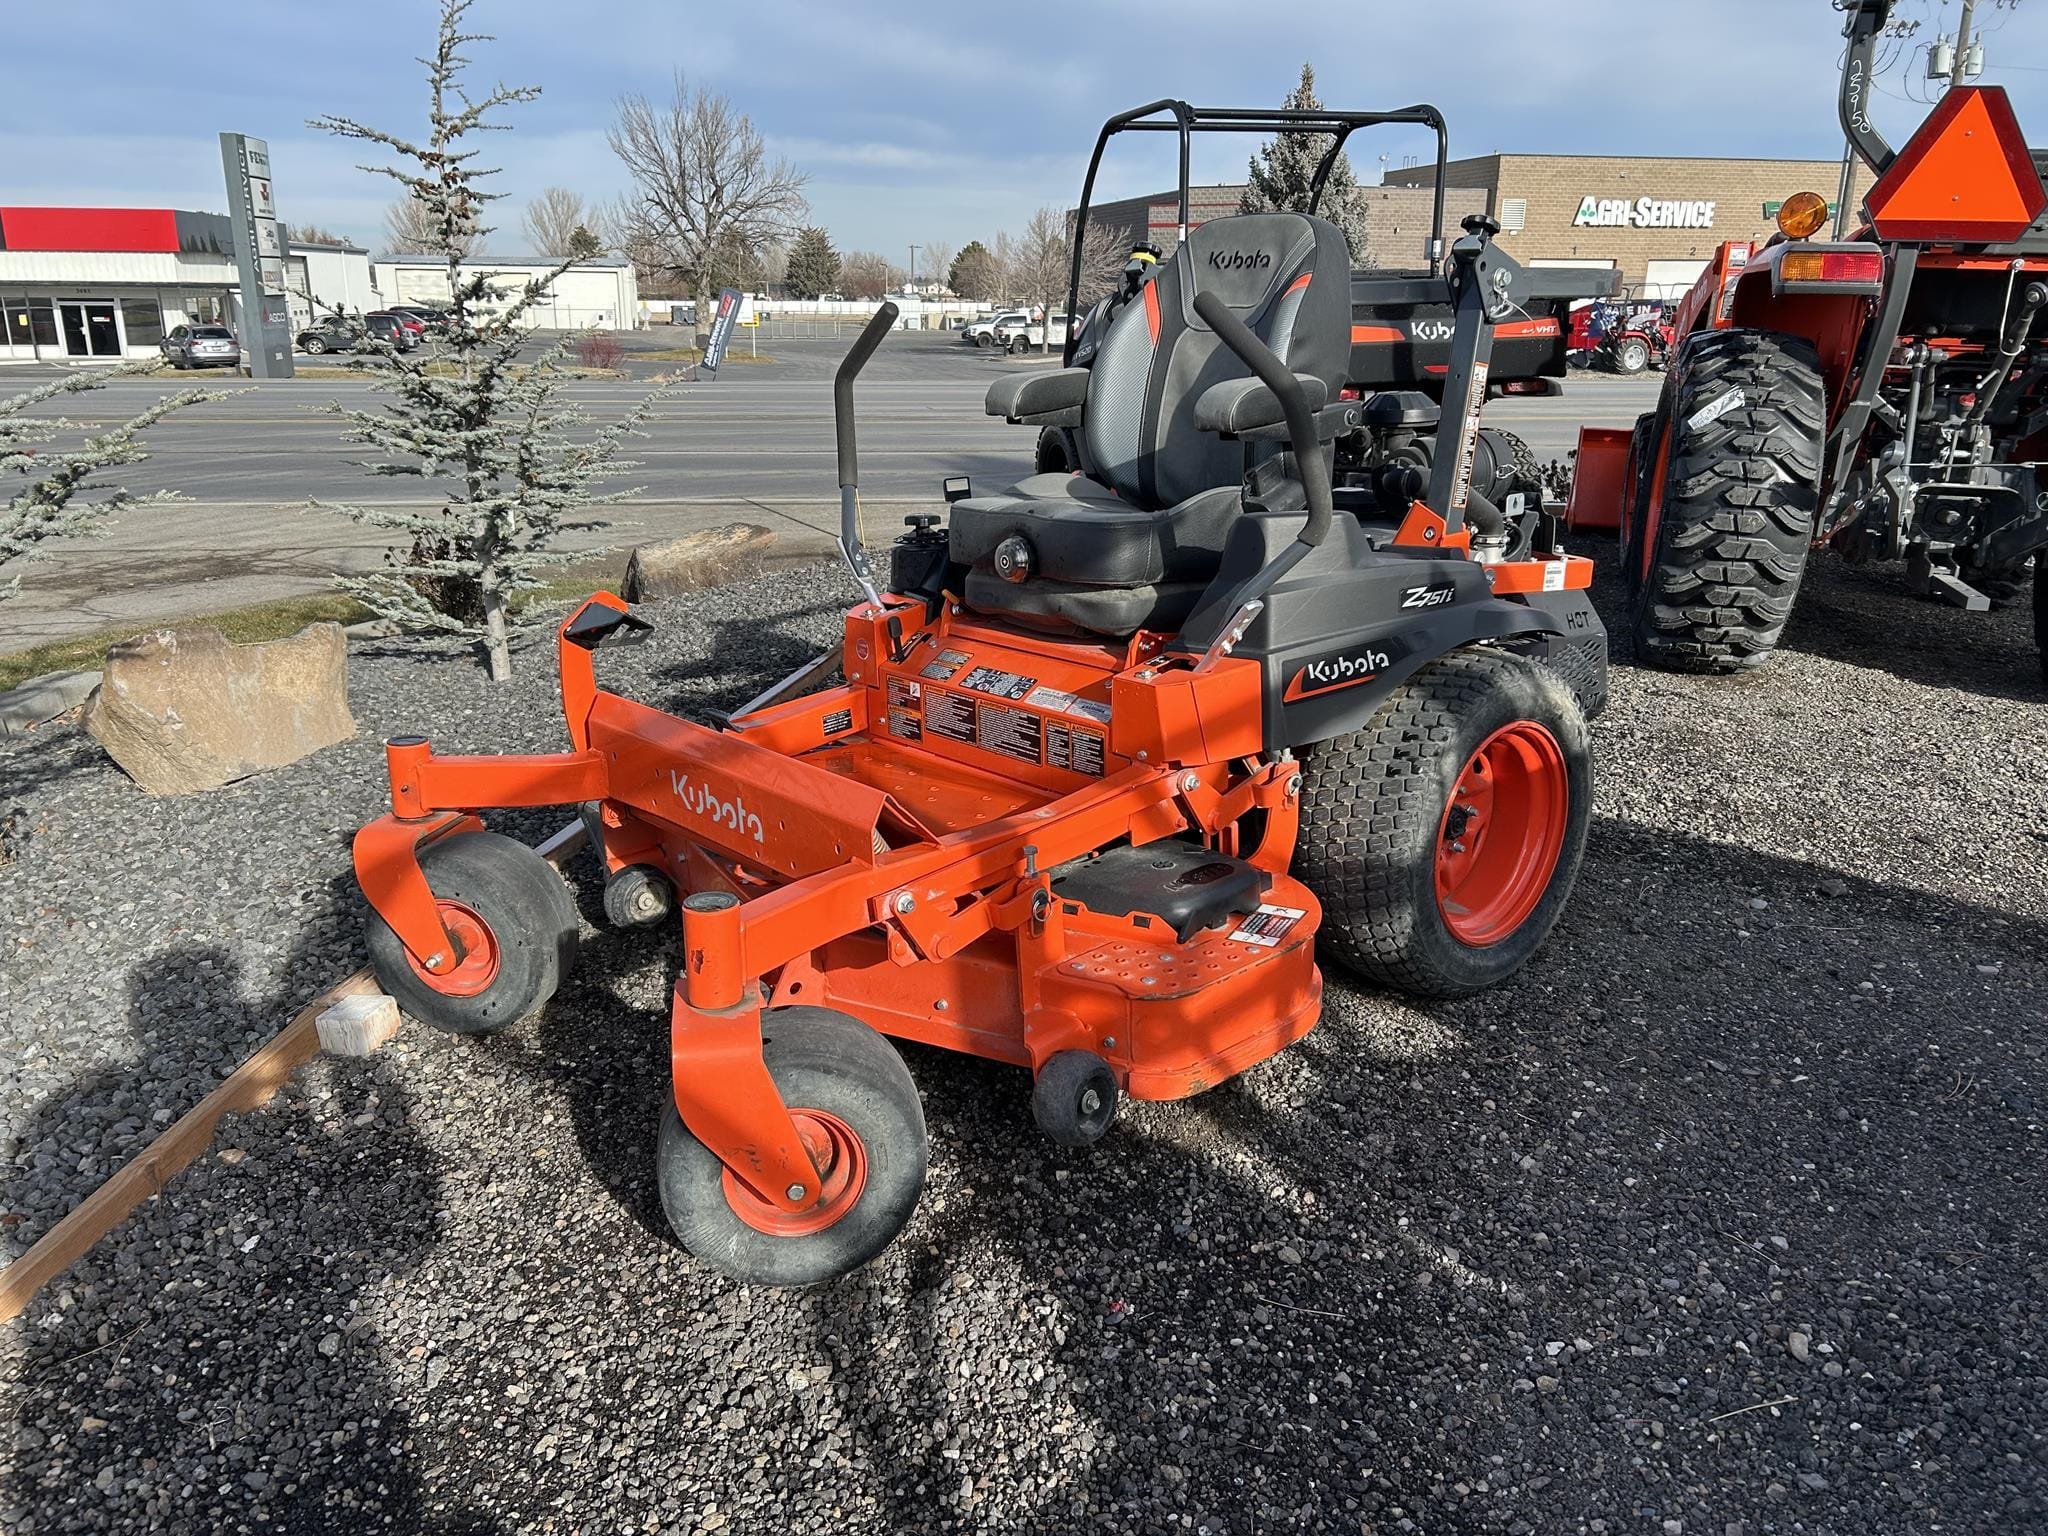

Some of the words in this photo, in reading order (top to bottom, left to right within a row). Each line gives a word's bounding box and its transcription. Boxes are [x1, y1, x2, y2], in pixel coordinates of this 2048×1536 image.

[1573, 196, 1715, 228] AGRI-SERVICE
[1209, 250, 1271, 269] Kubota
[1690, 247, 1697, 256] 2
[1637, 304, 1651, 315] IN
[1411, 321, 1456, 340] Kub
[1566, 610, 1589, 630] HOT
[1308, 649, 1390, 682] Kubota
[671, 769, 764, 843] Kubota
